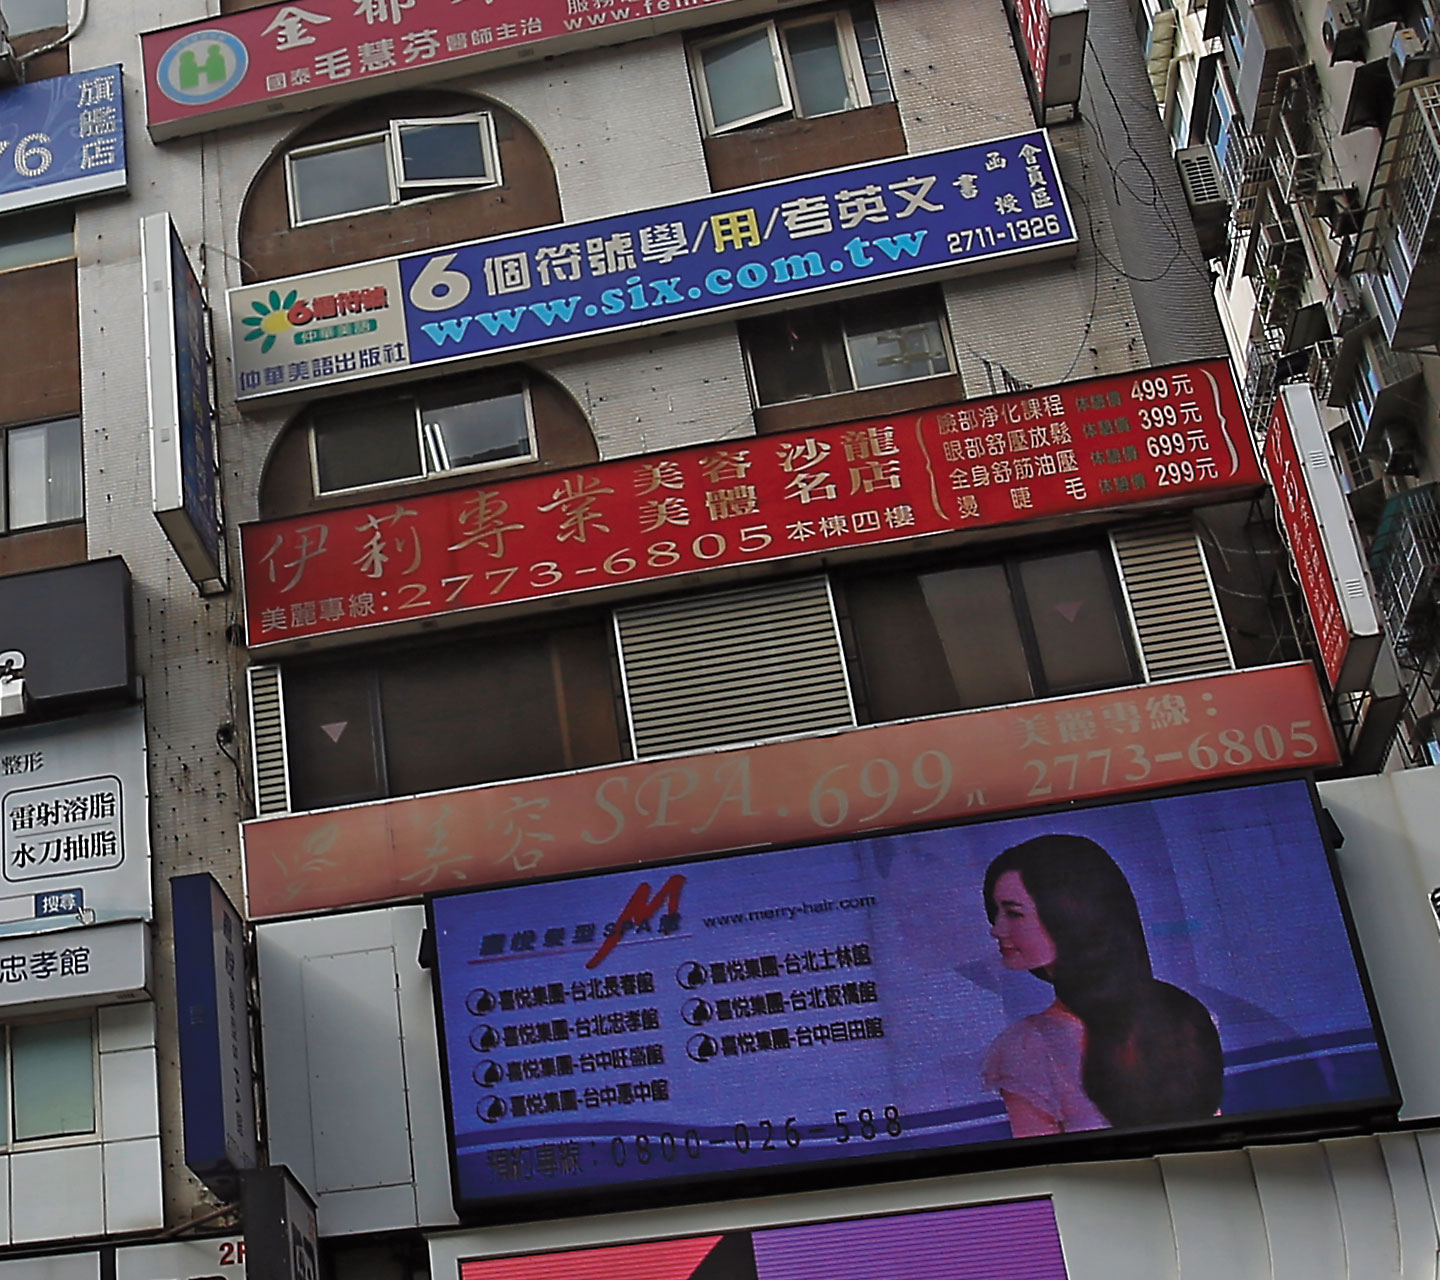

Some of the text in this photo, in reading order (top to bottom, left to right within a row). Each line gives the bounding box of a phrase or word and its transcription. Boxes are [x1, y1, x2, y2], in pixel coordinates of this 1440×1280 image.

[1018, 143, 1054, 210] 會員區
[946, 214, 1061, 255] 2711-1326
[419, 229, 929, 348] www.six.com.tw
[239, 342, 407, 390] 仲華美語出版社
[1131, 373, 1195, 403] 499元
[1138, 401, 1203, 431] 399元
[1146, 429, 1210, 460] 699元
[1154, 457, 1219, 487] 299元
[260, 472, 618, 595] 伊莉專業
[396, 518, 776, 613] 2773-6805
[784, 505, 916, 547] 本棟四樓
[1, 751, 44, 775] 整形
[1022, 717, 1319, 799] 2773-6805
[9, 790, 117, 832] 雷射溶脂
[10, 830, 118, 869] 水刀抽脂
[40, 893, 78, 914] 搜尋
[610, 1105, 904, 1168] 0800-026-588
